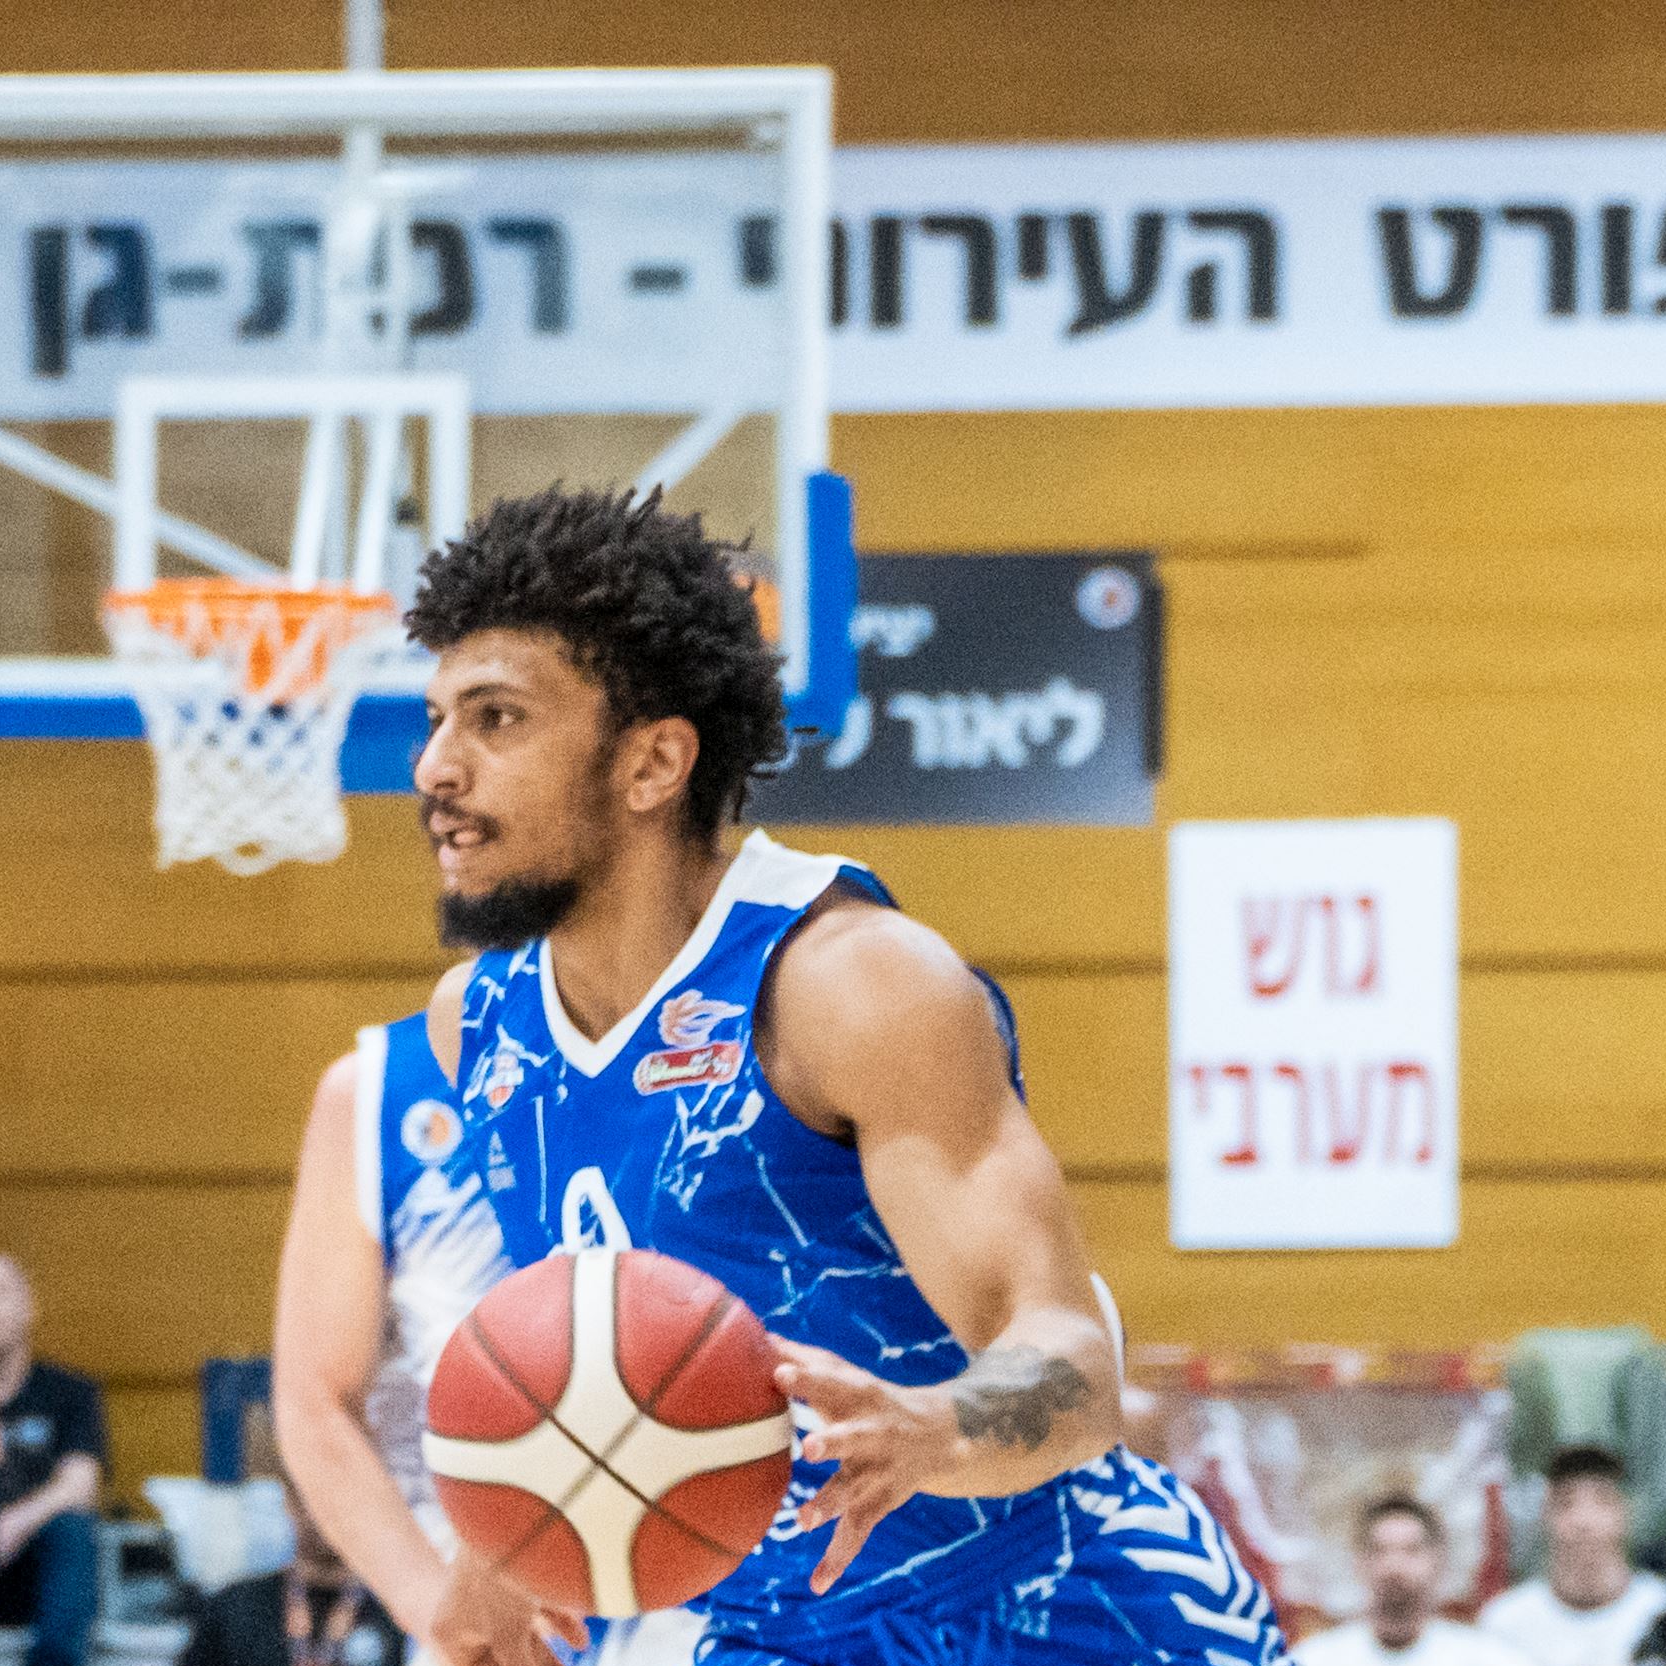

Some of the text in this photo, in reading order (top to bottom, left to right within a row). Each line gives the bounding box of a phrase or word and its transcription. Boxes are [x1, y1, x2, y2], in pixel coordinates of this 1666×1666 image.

[890, 676, 1105, 769] ליאור
[1241, 894, 1383, 999] גוש
[1188, 1060, 1437, 1169] מערבי
